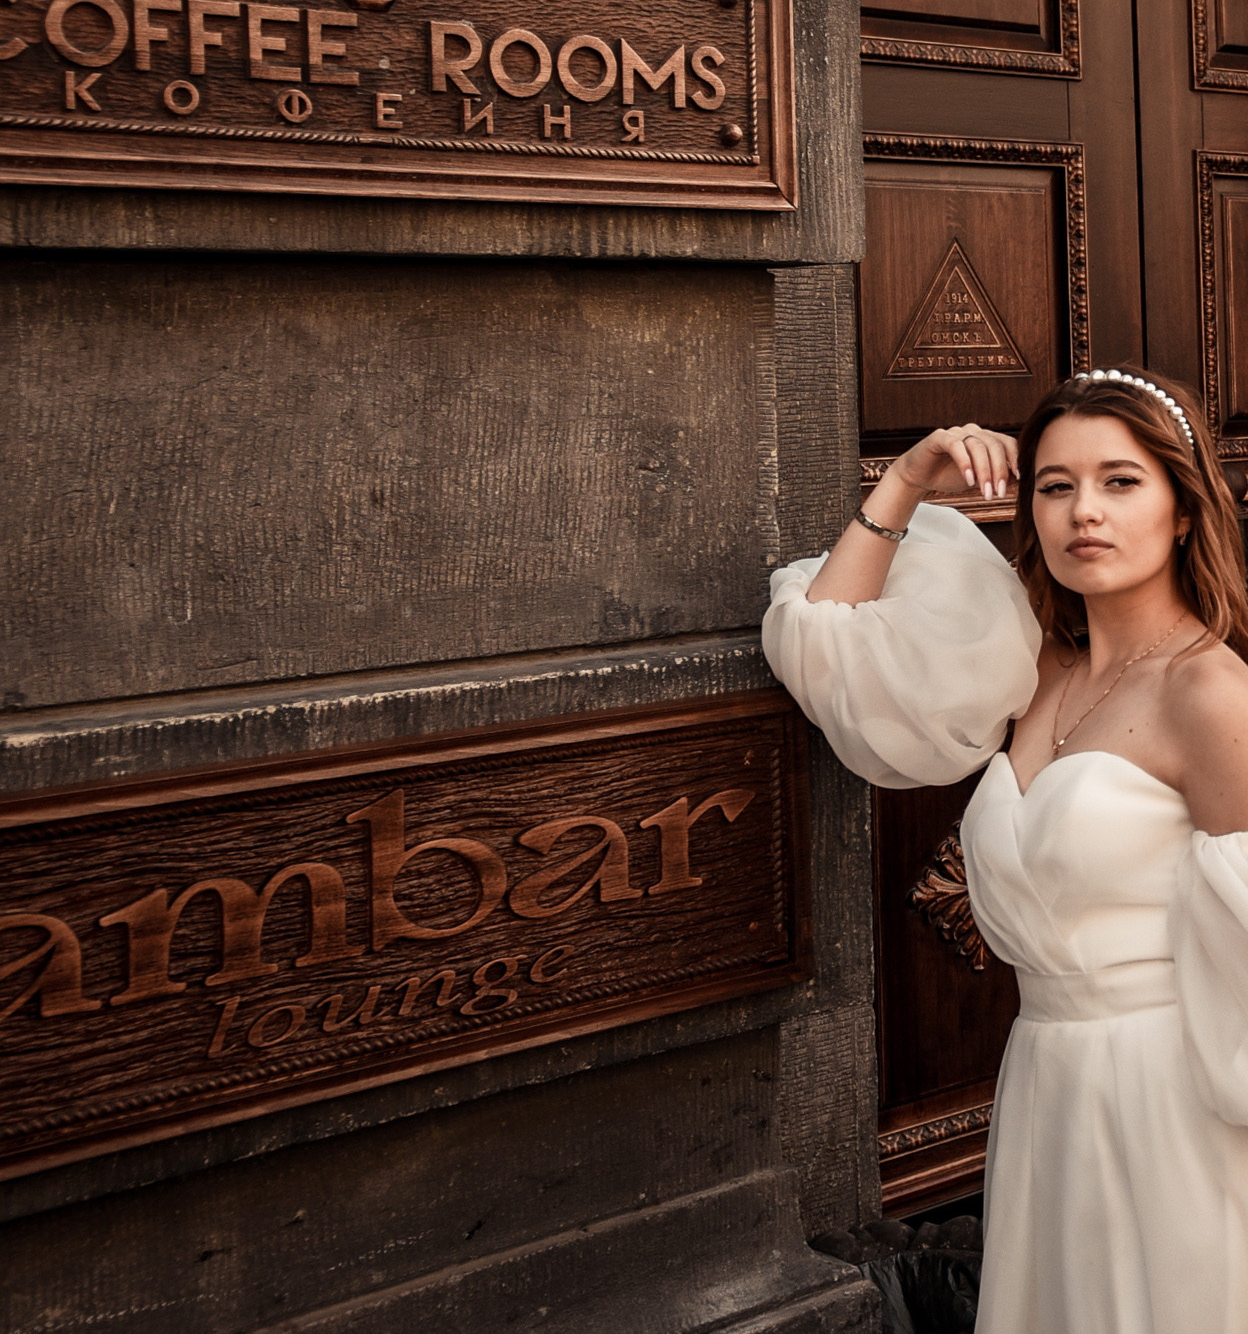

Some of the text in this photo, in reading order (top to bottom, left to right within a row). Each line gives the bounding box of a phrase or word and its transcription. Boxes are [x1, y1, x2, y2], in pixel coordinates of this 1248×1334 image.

[429, 20, 726, 111] ROOMS
[65, 71, 645, 143] КОФЕЙНЯ
[945, 293, 969, 305] 1914
[206, 944, 575, 1059] lounge
